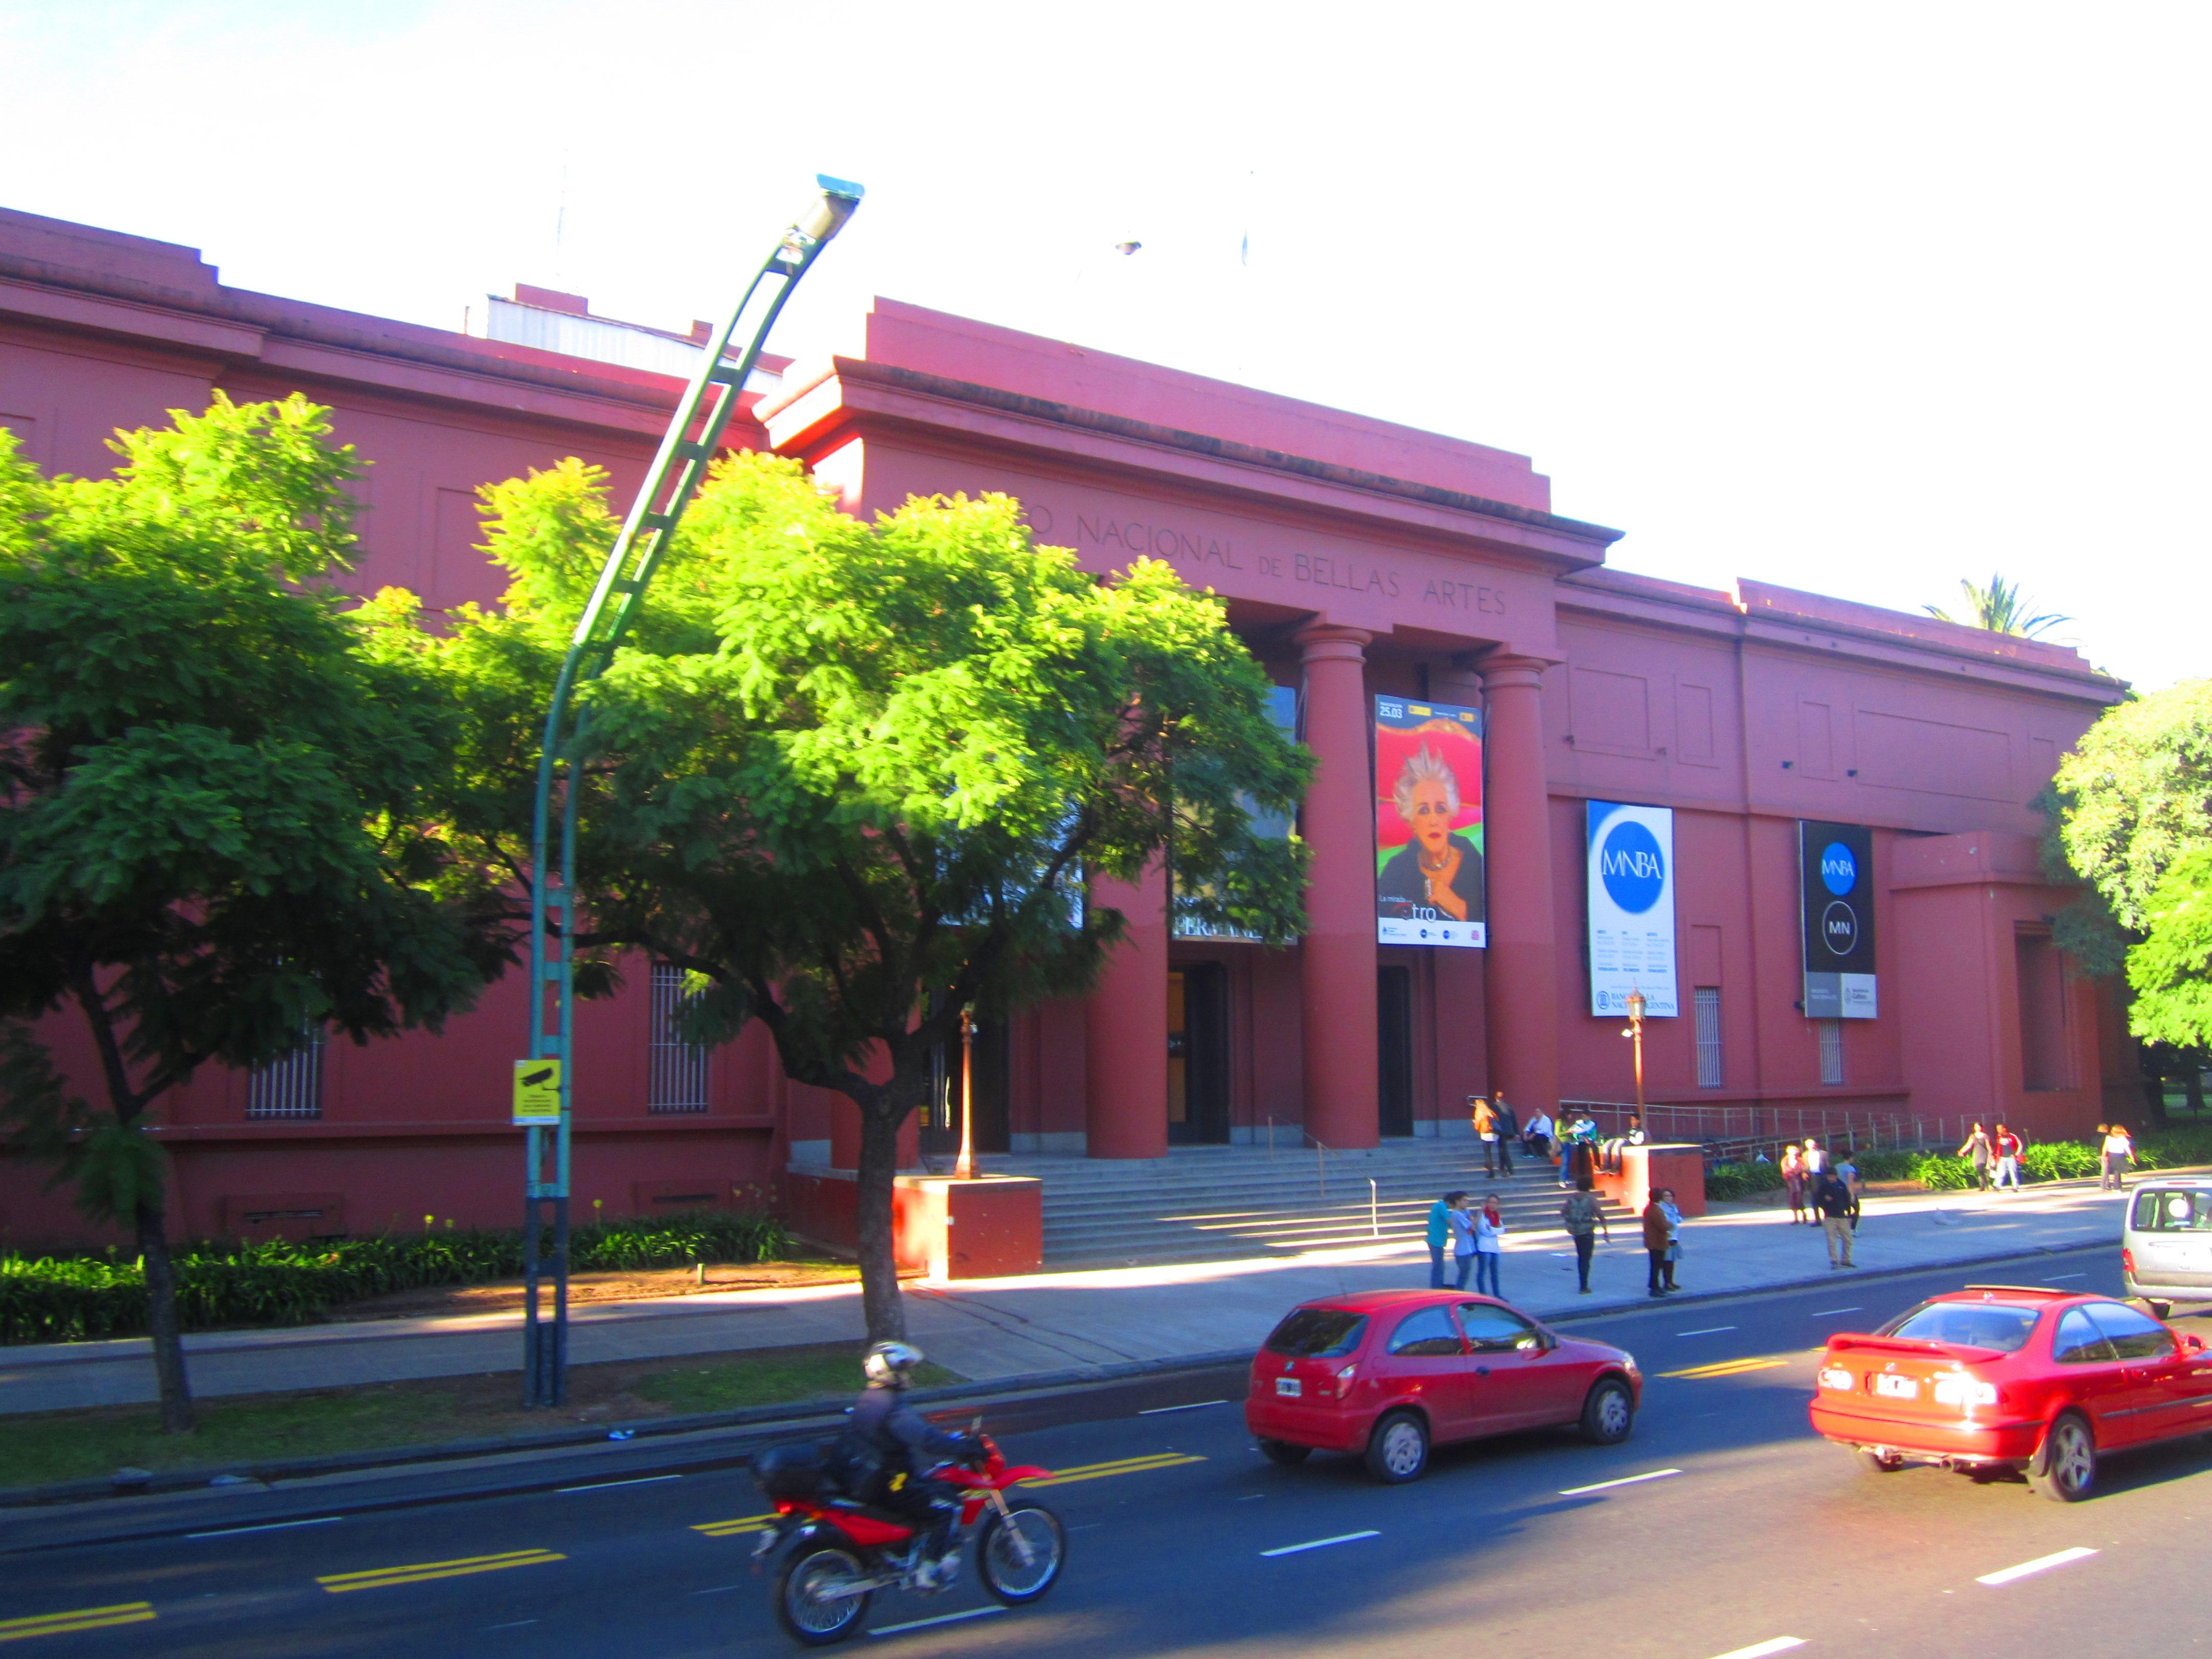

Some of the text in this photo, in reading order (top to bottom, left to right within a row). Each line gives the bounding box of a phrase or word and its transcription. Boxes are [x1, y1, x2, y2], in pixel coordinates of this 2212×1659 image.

[1077, 514, 1506, 615] NACIONAL DE BELLAS ARTES
[1379, 706, 1403, 719] 25.03
[1602, 849, 1663, 880] MNBA
[1821, 859, 1855, 877] MNBA
[1828, 921, 1851, 935] MN
